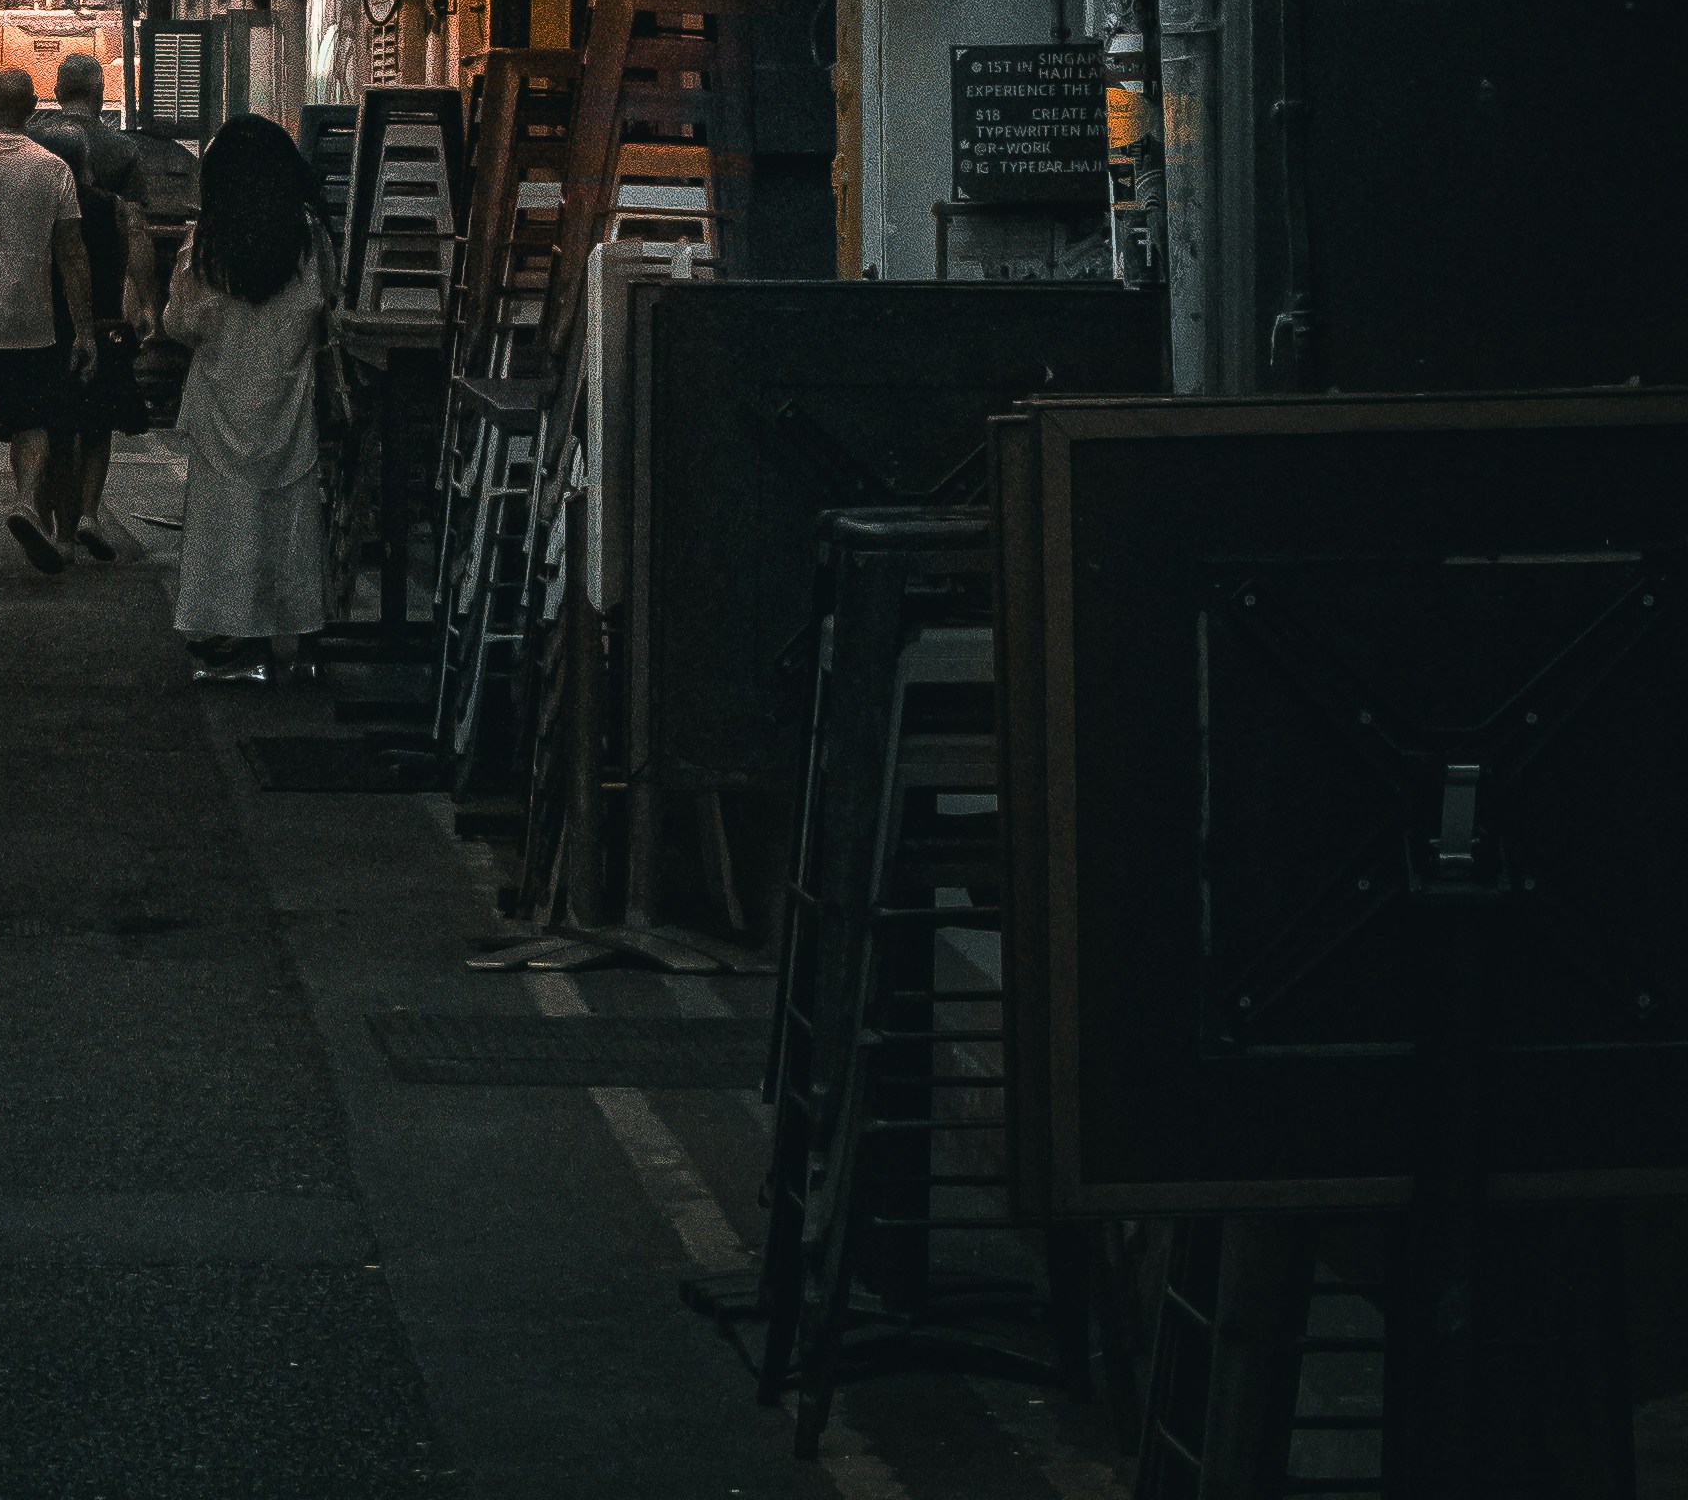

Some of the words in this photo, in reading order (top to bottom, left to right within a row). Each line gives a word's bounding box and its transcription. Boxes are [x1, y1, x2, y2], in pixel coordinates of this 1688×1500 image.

[986, 60, 1011, 74] 1ST
[1017, 60, 1033, 74] IN
[1038, 67, 1074, 80] HAJI
[966, 84, 1057, 99] EXPERIENCE
[1063, 83, 1092, 97] THE
[975, 108, 1001, 122] $18
[1031, 107, 1088, 121] CREATE
[976, 124, 1082, 139] TYPEWRITTEN
